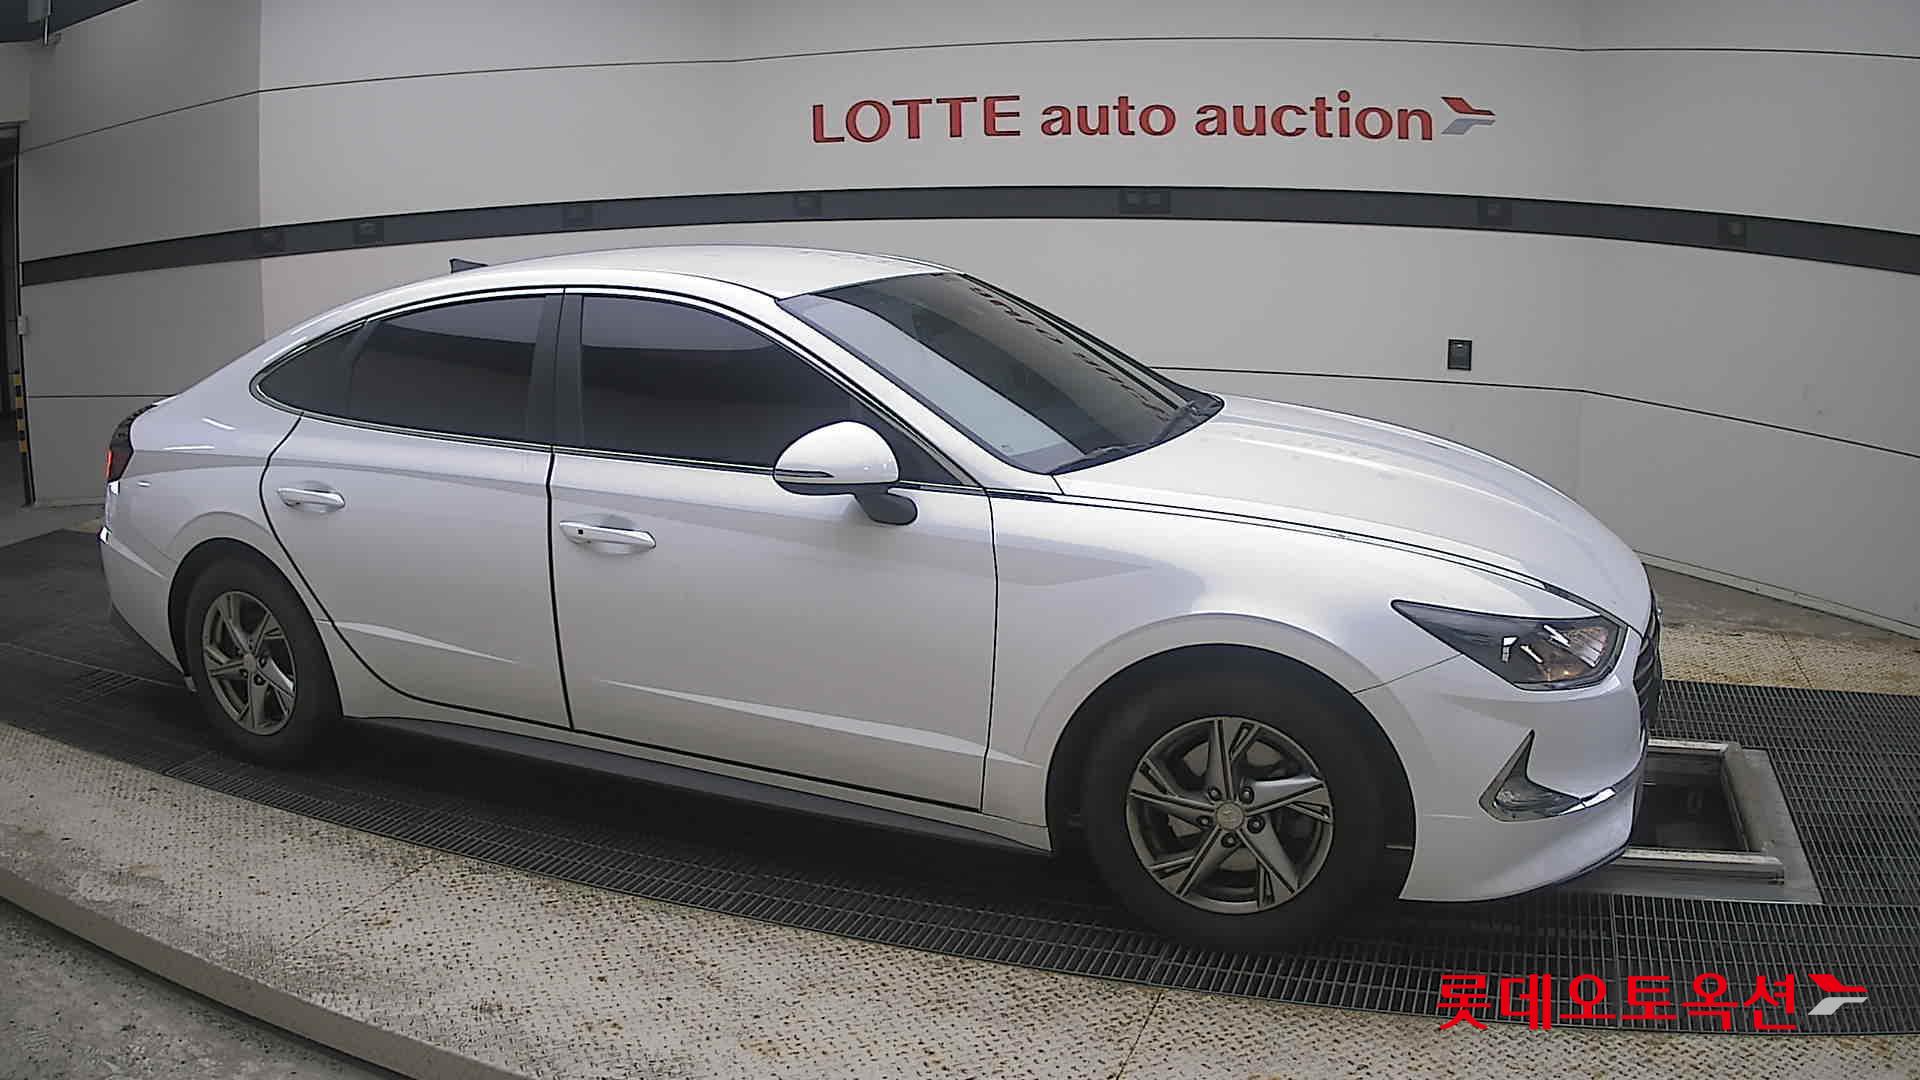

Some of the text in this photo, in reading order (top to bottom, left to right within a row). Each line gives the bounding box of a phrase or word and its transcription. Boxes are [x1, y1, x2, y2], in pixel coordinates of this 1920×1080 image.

[812, 90, 1434, 144] LOTTE auto auction
